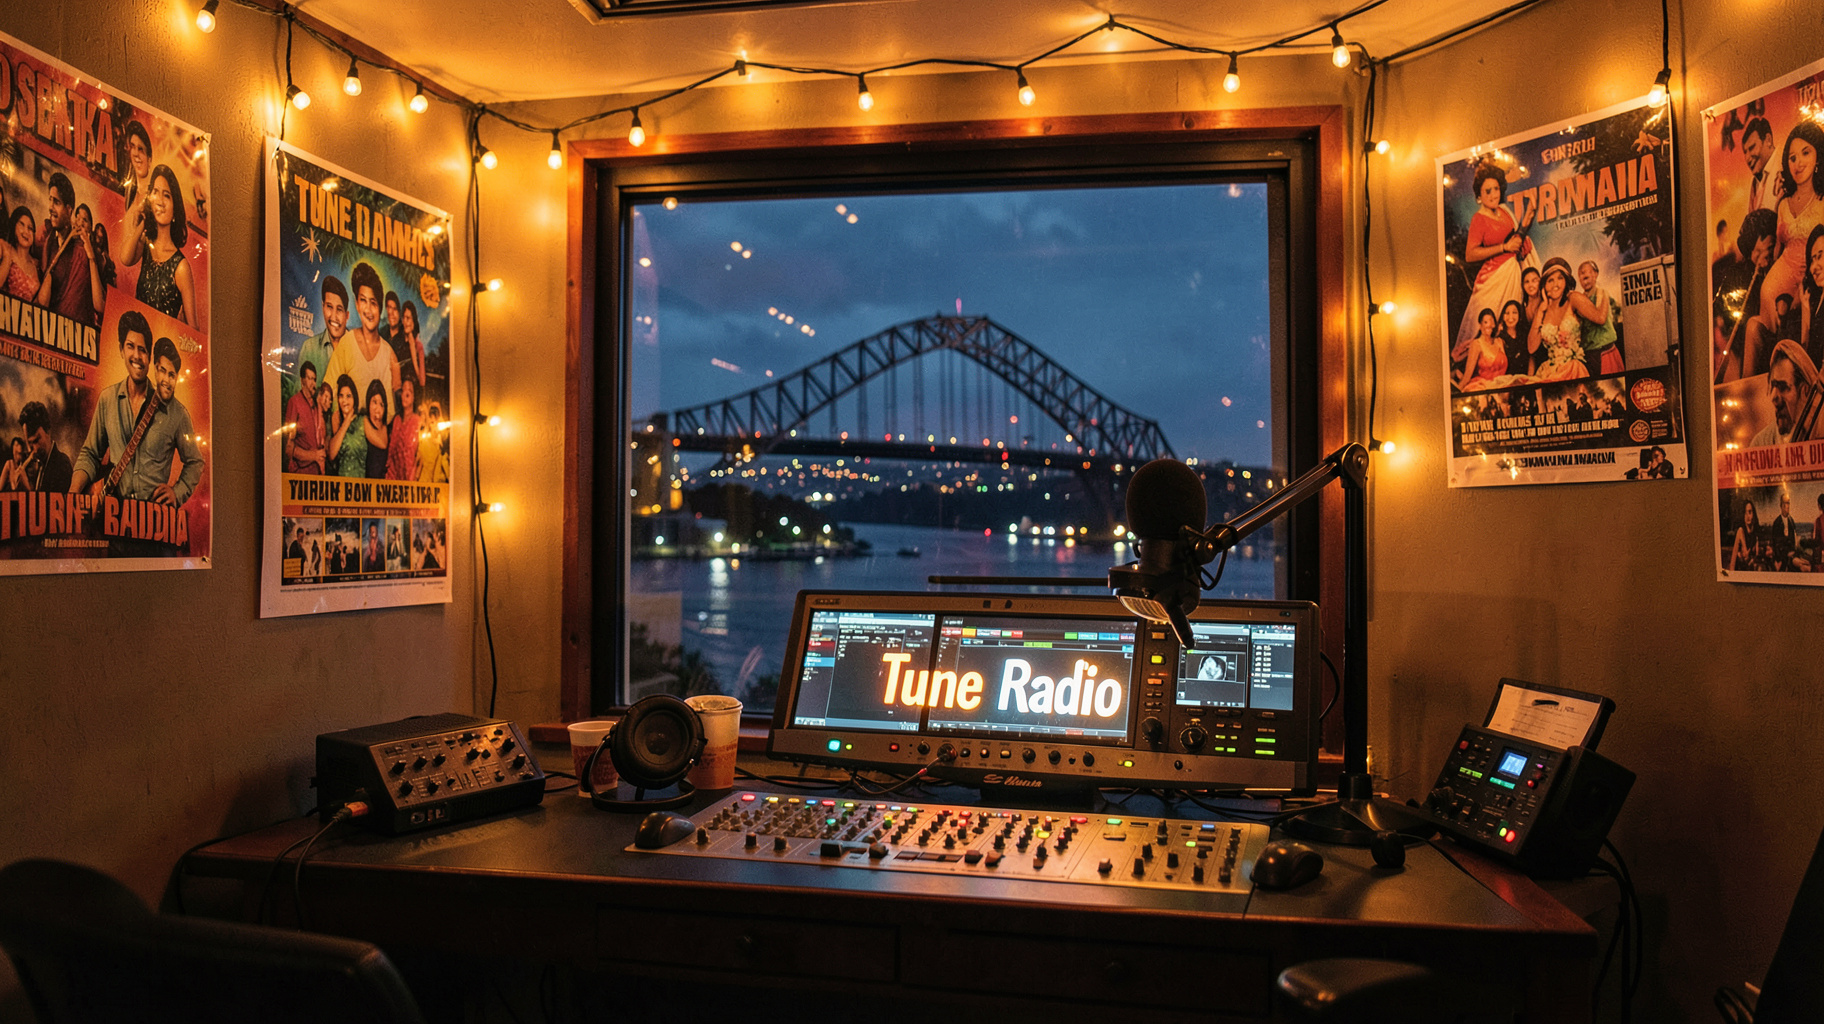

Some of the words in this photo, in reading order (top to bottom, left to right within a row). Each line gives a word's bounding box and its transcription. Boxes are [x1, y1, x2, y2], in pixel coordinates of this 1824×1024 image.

[295, 174, 353, 241] TUNE
[882, 652, 984, 711] Tune
[998, 658, 1122, 718] Radio
